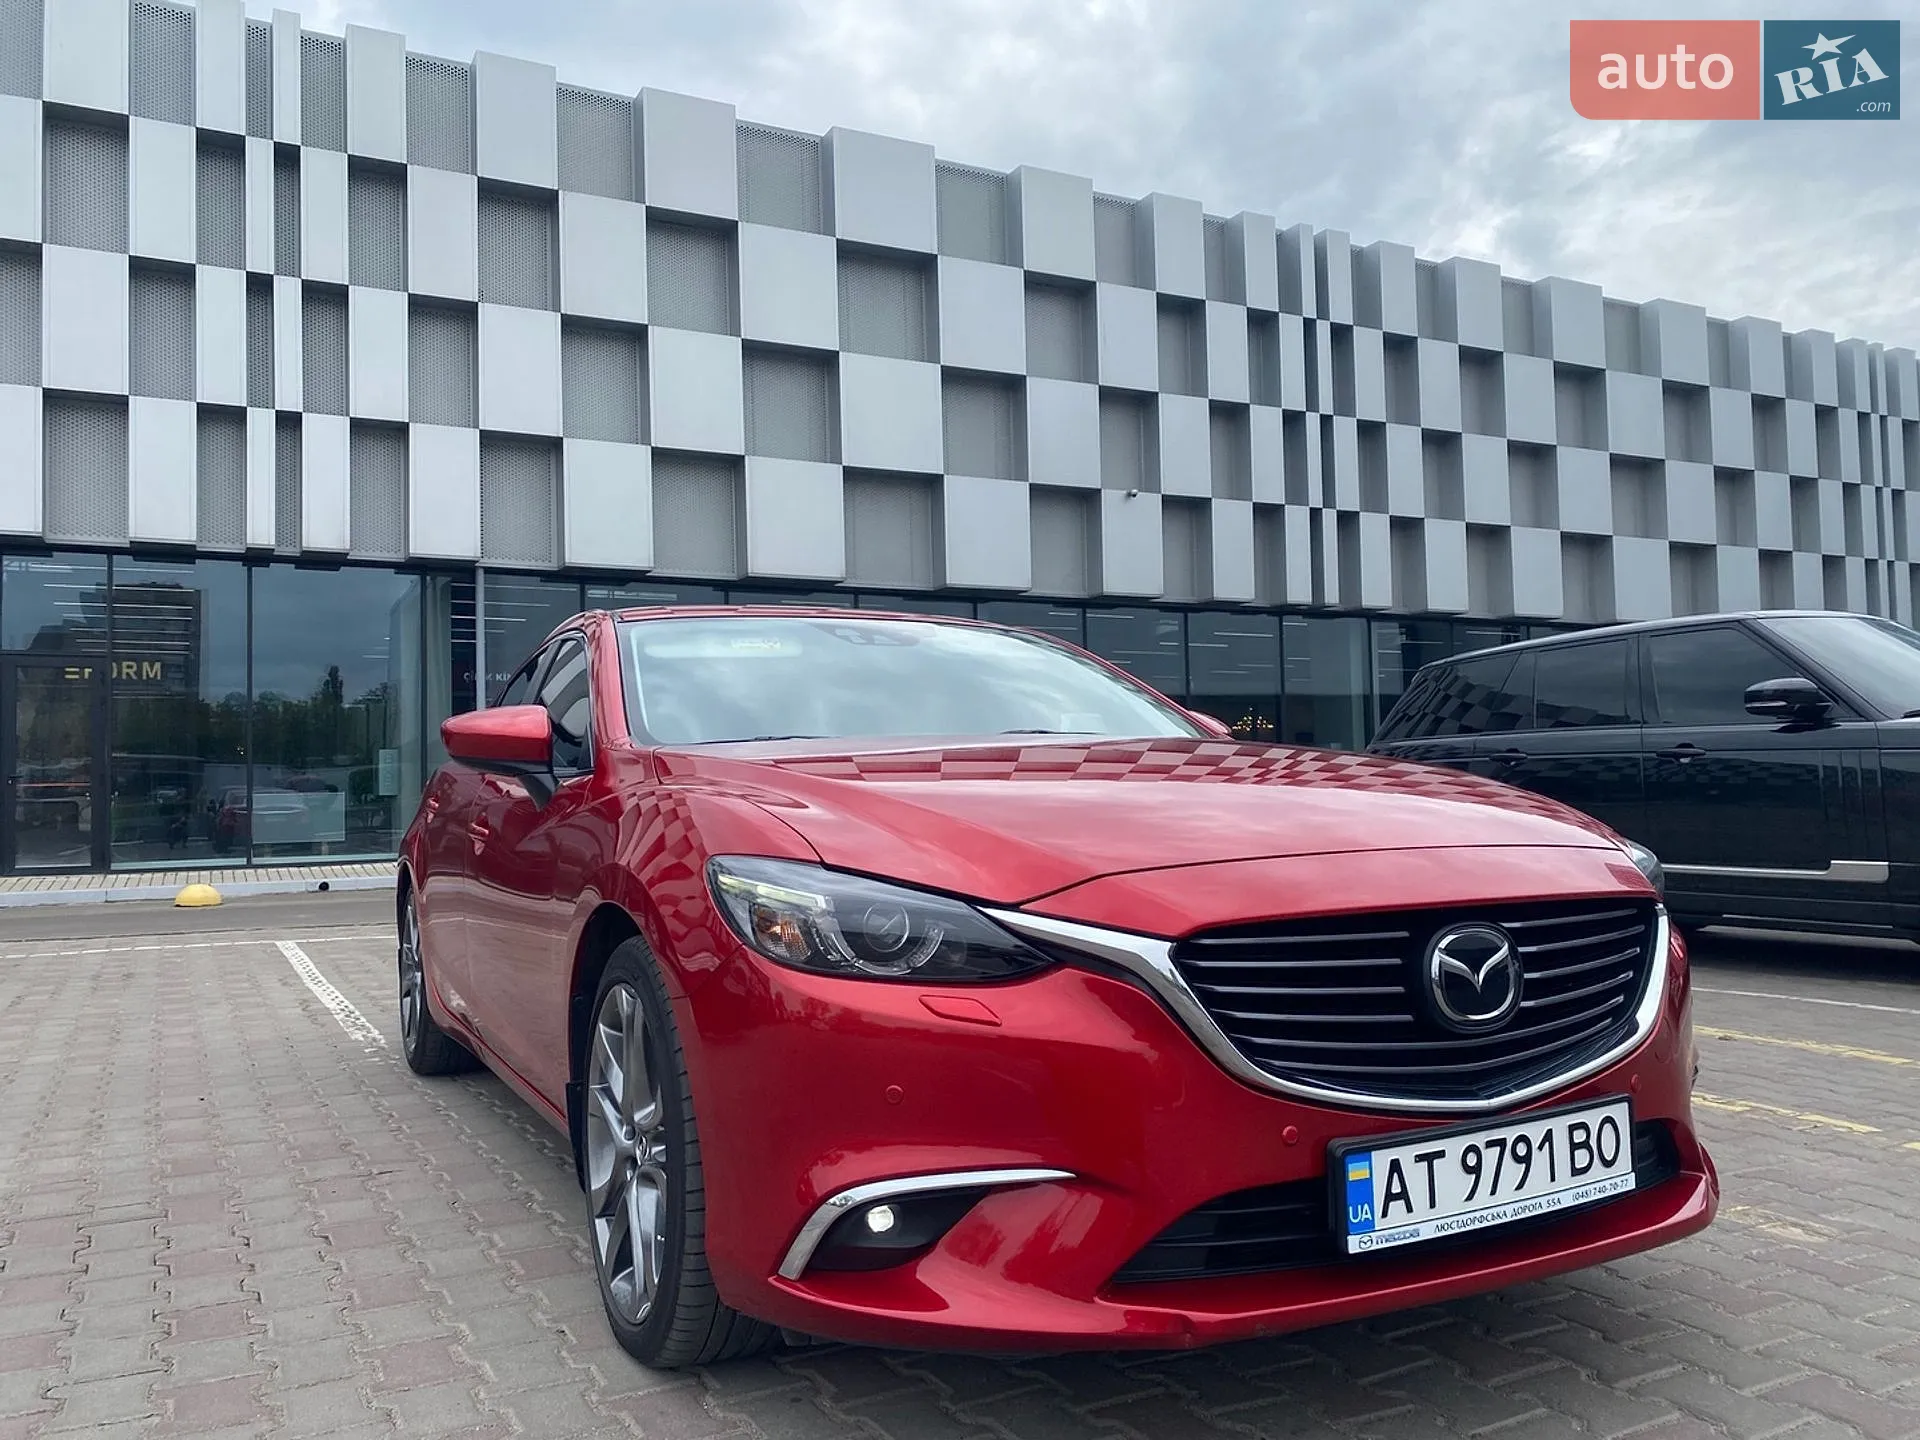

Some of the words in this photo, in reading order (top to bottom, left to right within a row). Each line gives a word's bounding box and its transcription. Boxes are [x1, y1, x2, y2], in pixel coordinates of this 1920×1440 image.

[1381, 1149, 1445, 1219] AT
[1461, 1128, 1556, 1202] 9791
[1569, 1115, 1621, 1176] BO
[1349, 1203, 1372, 1223] UA
[1511, 1202, 1543, 1218] ДОРОГА
